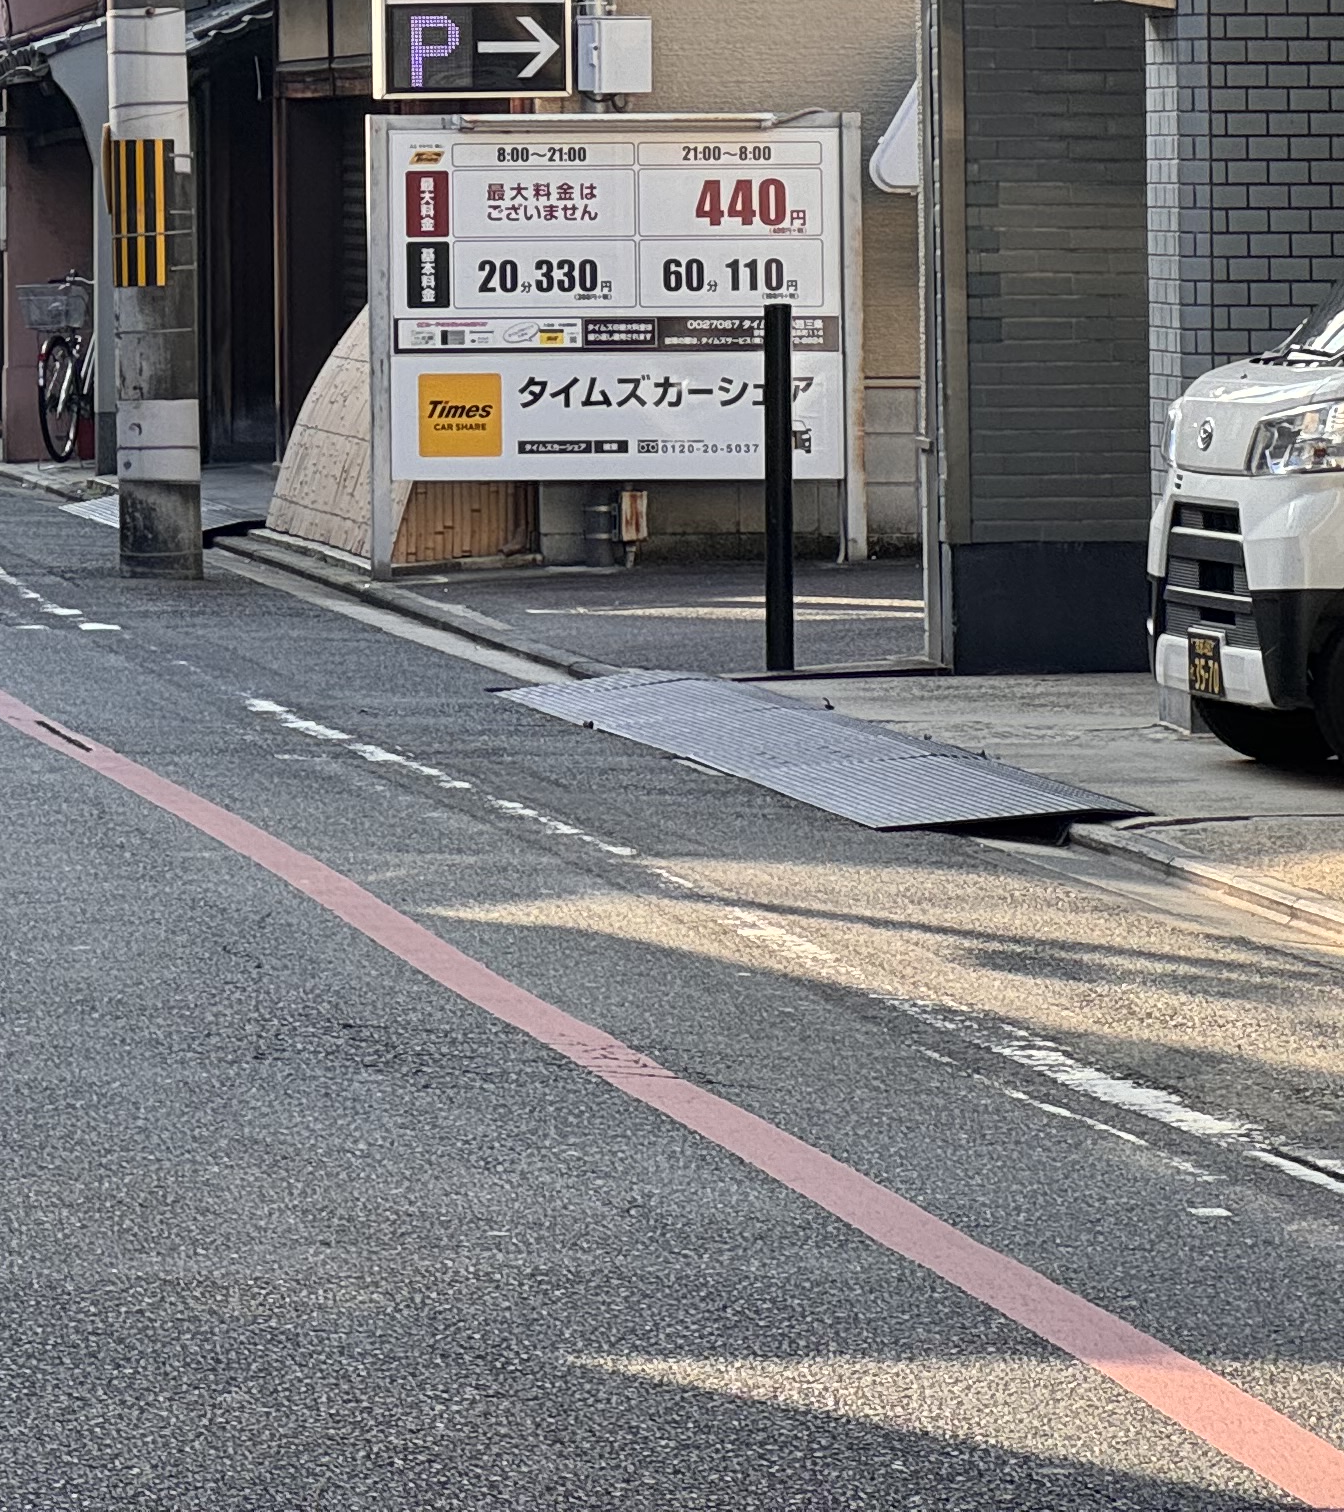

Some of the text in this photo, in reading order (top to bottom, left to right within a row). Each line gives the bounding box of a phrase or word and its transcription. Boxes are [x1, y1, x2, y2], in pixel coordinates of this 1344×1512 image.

[410, 14, 460, 88] P
[486, 182, 598, 202] 最大料金は
[486, 204, 599, 222] ございません
[427, 400, 494, 419] Times
[433, 423, 487, 431] CAR SHARE
[661, 443, 761, 454] 0120-20-5037
